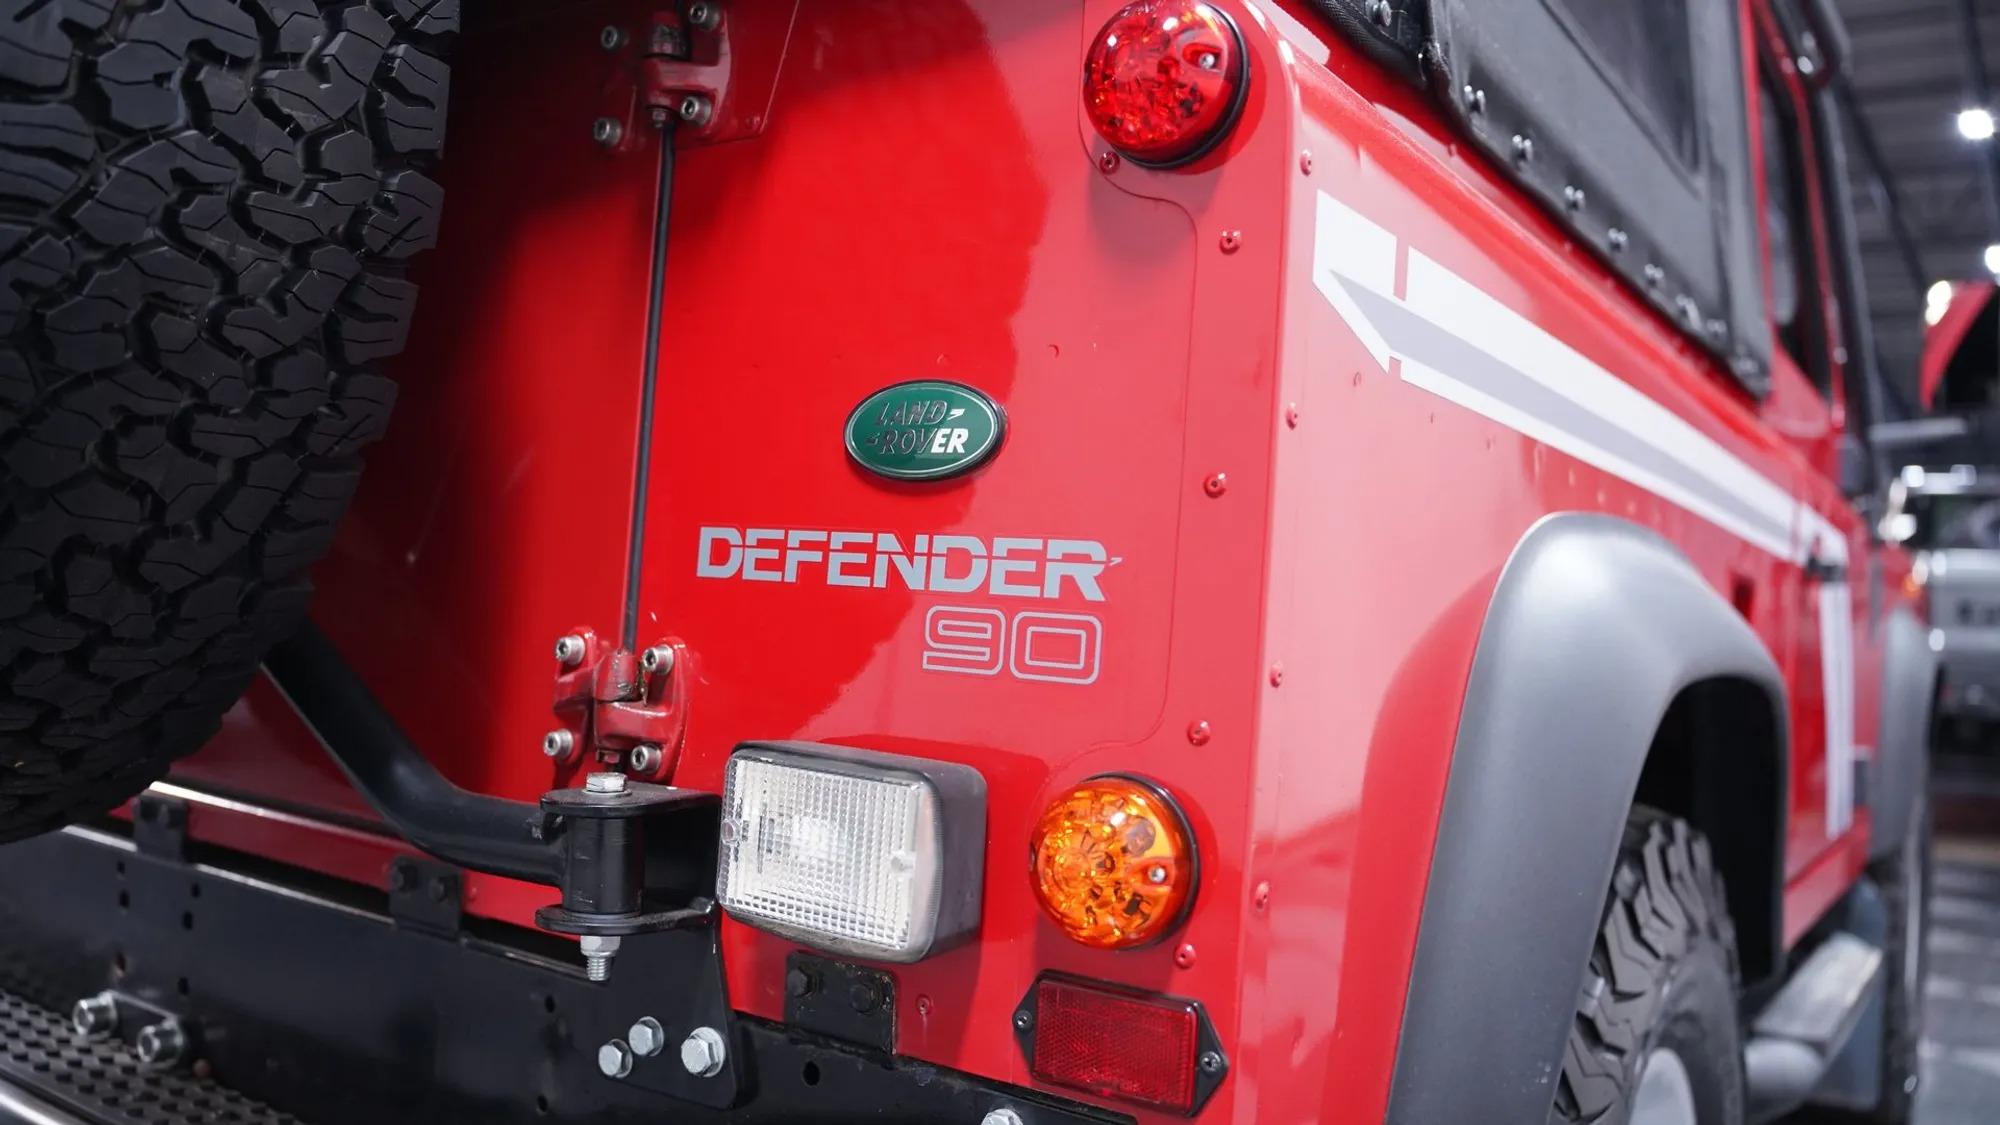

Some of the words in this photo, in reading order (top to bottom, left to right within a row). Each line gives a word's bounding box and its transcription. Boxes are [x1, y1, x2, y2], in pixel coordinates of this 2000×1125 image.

[876, 400, 946, 426] LAND
[880, 428, 969, 455] ROVER
[697, 526, 1107, 601] DEFENDER
[922, 605, 1101, 685] 90
